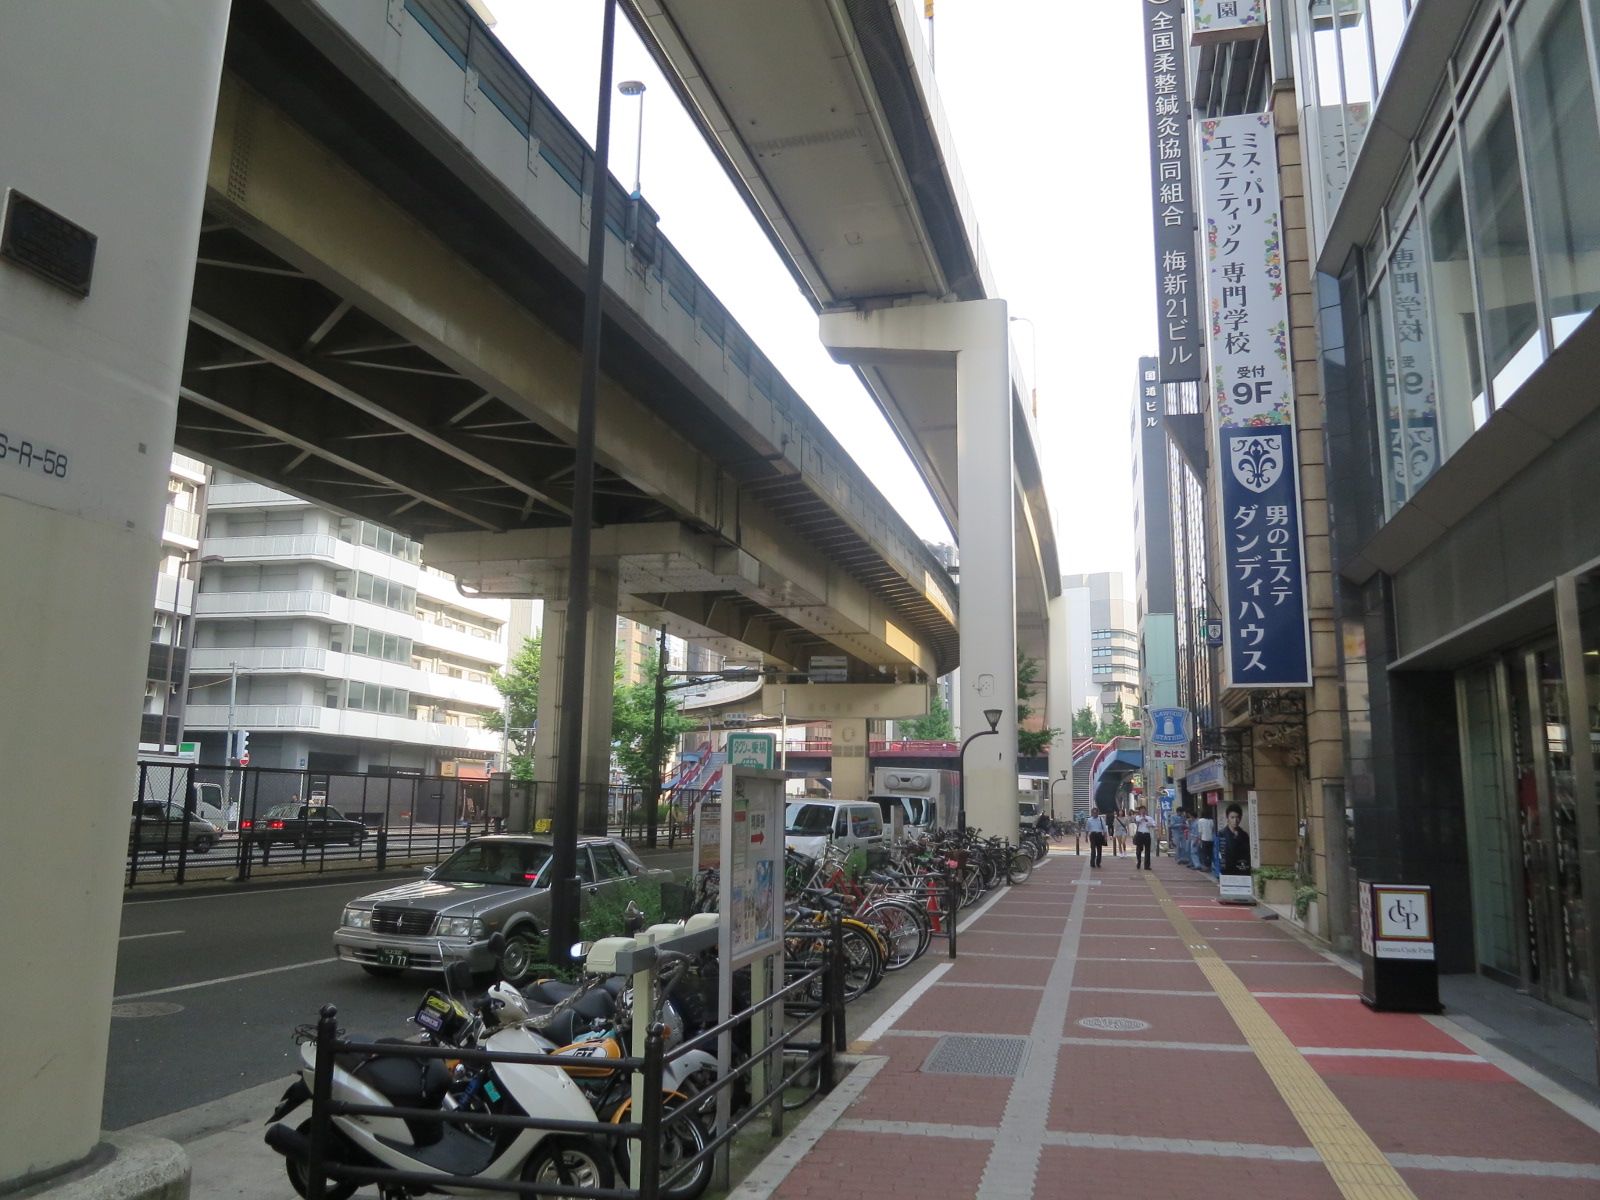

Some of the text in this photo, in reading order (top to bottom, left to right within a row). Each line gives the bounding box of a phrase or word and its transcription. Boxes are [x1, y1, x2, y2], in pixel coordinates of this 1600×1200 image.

[1217, 0, 1238, 19] 園
[1151, 11, 1192, 366] 全国柔整鍼灸協同組合 梅新21ビル
[1241, 131, 1264, 216] ミス・パリ
[1213, 134, 1251, 356] エステティック 専門学校
[1144, 370, 1158, 427] 国道ビル
[1232, 380, 1273, 406] 9F
[1236, 365, 1265, 379] 受付
[1233, 503, 1267, 672] ダンディハウス
[1265, 505, 1293, 606] 男のエステ
